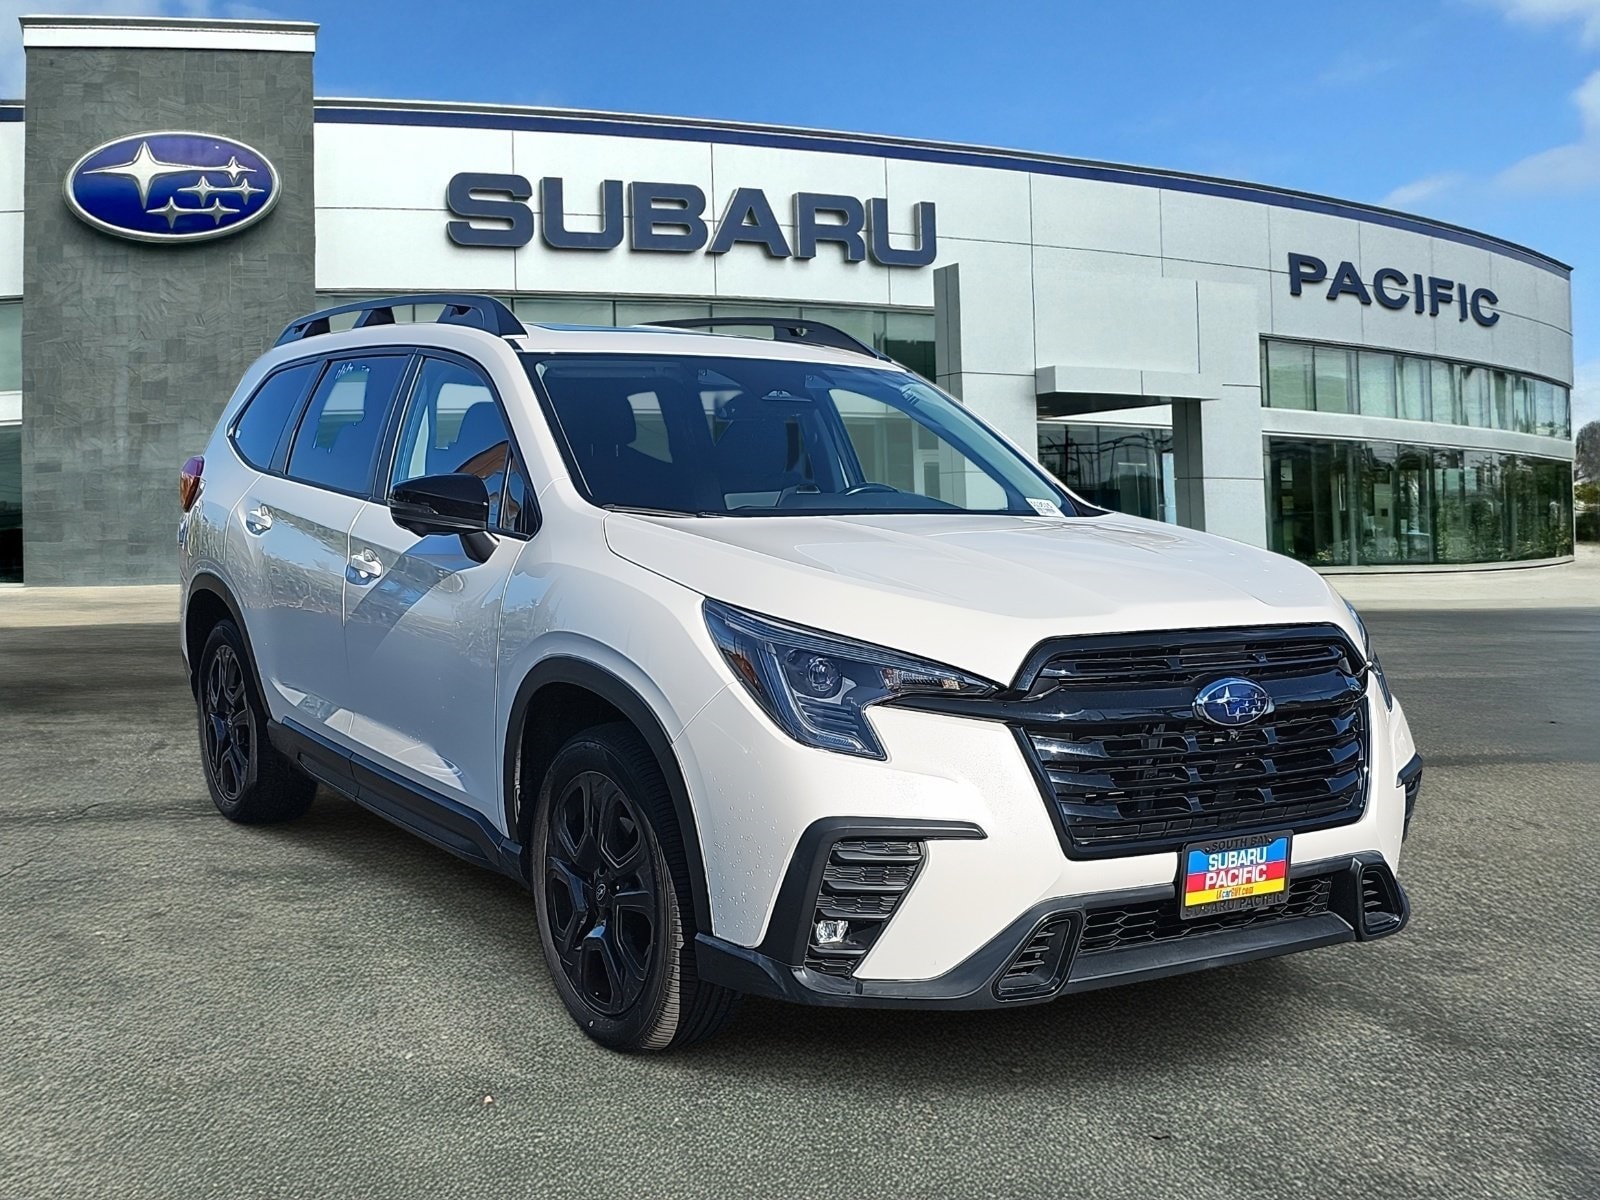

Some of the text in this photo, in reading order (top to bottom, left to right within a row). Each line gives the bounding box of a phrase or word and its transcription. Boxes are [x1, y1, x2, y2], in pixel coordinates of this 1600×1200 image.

[447, 172, 937, 269] SUBARU
[1288, 252, 1500, 328] PACIFIC
[1212, 837, 1247, 851] SOUTH
[1208, 846, 1267, 872] SUBARU
[1205, 864, 1267, 890] PACIFIC
